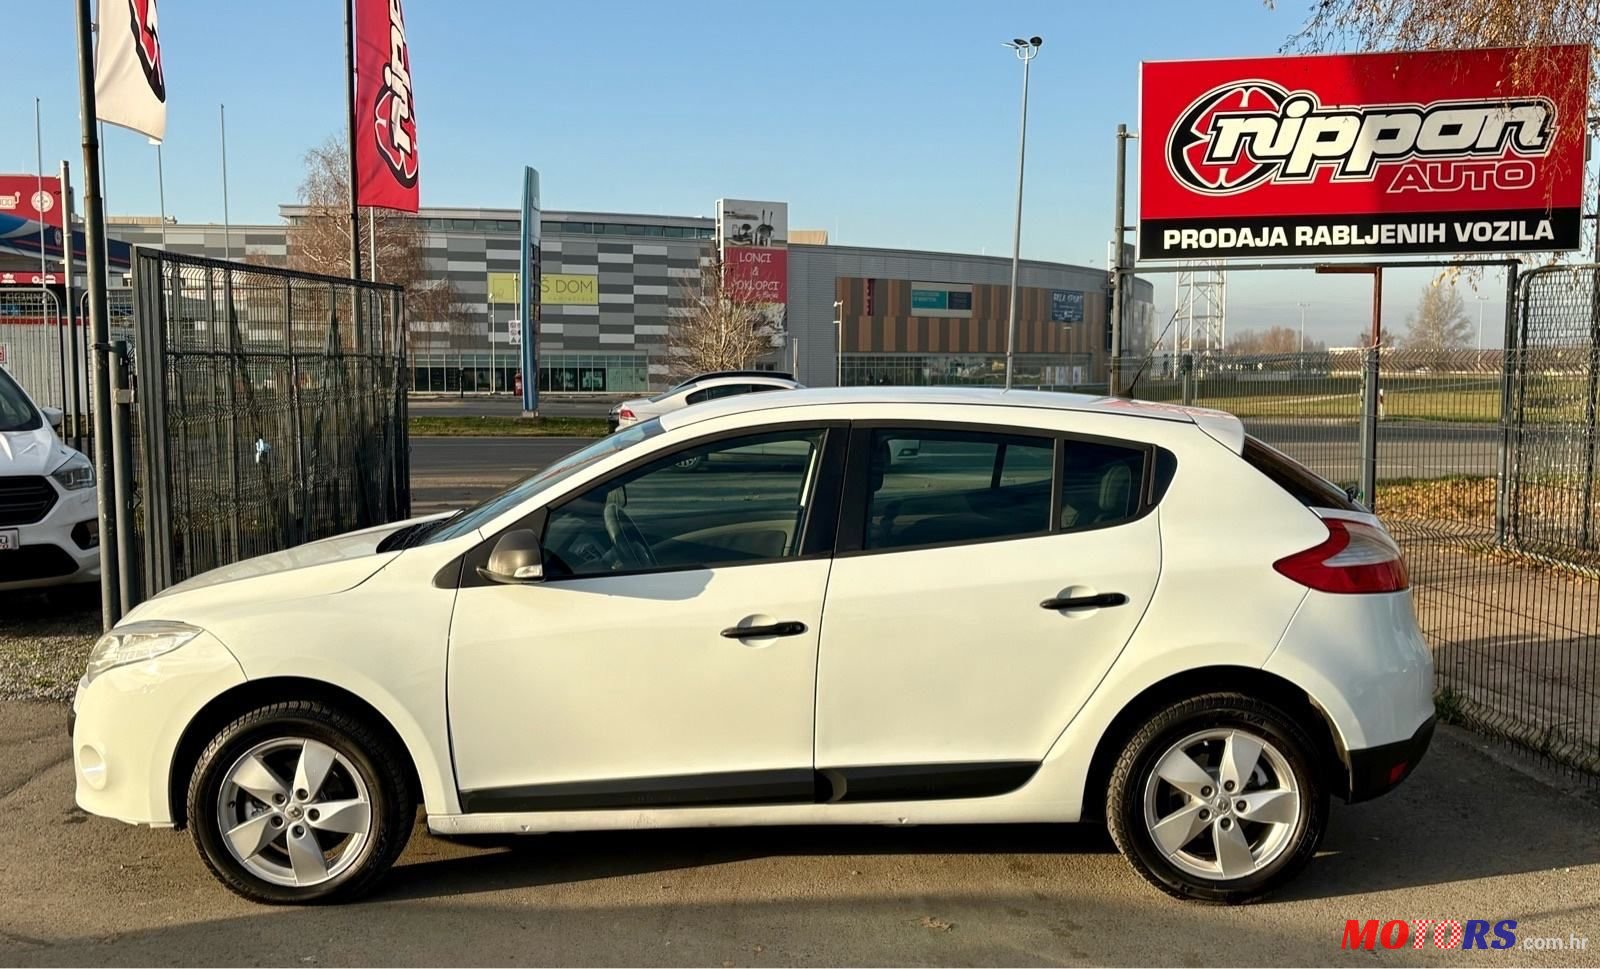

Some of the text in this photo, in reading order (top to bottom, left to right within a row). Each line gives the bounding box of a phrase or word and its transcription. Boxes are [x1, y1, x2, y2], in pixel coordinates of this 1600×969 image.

[1206, 95, 1553, 180] nippon
[1386, 160, 1535, 193] AUTO
[1163, 219, 1555, 250] PRODAJA RABLJENIH VOZILA
[739, 252, 772, 264] LONCI
[555, 280, 593, 294] DOM
